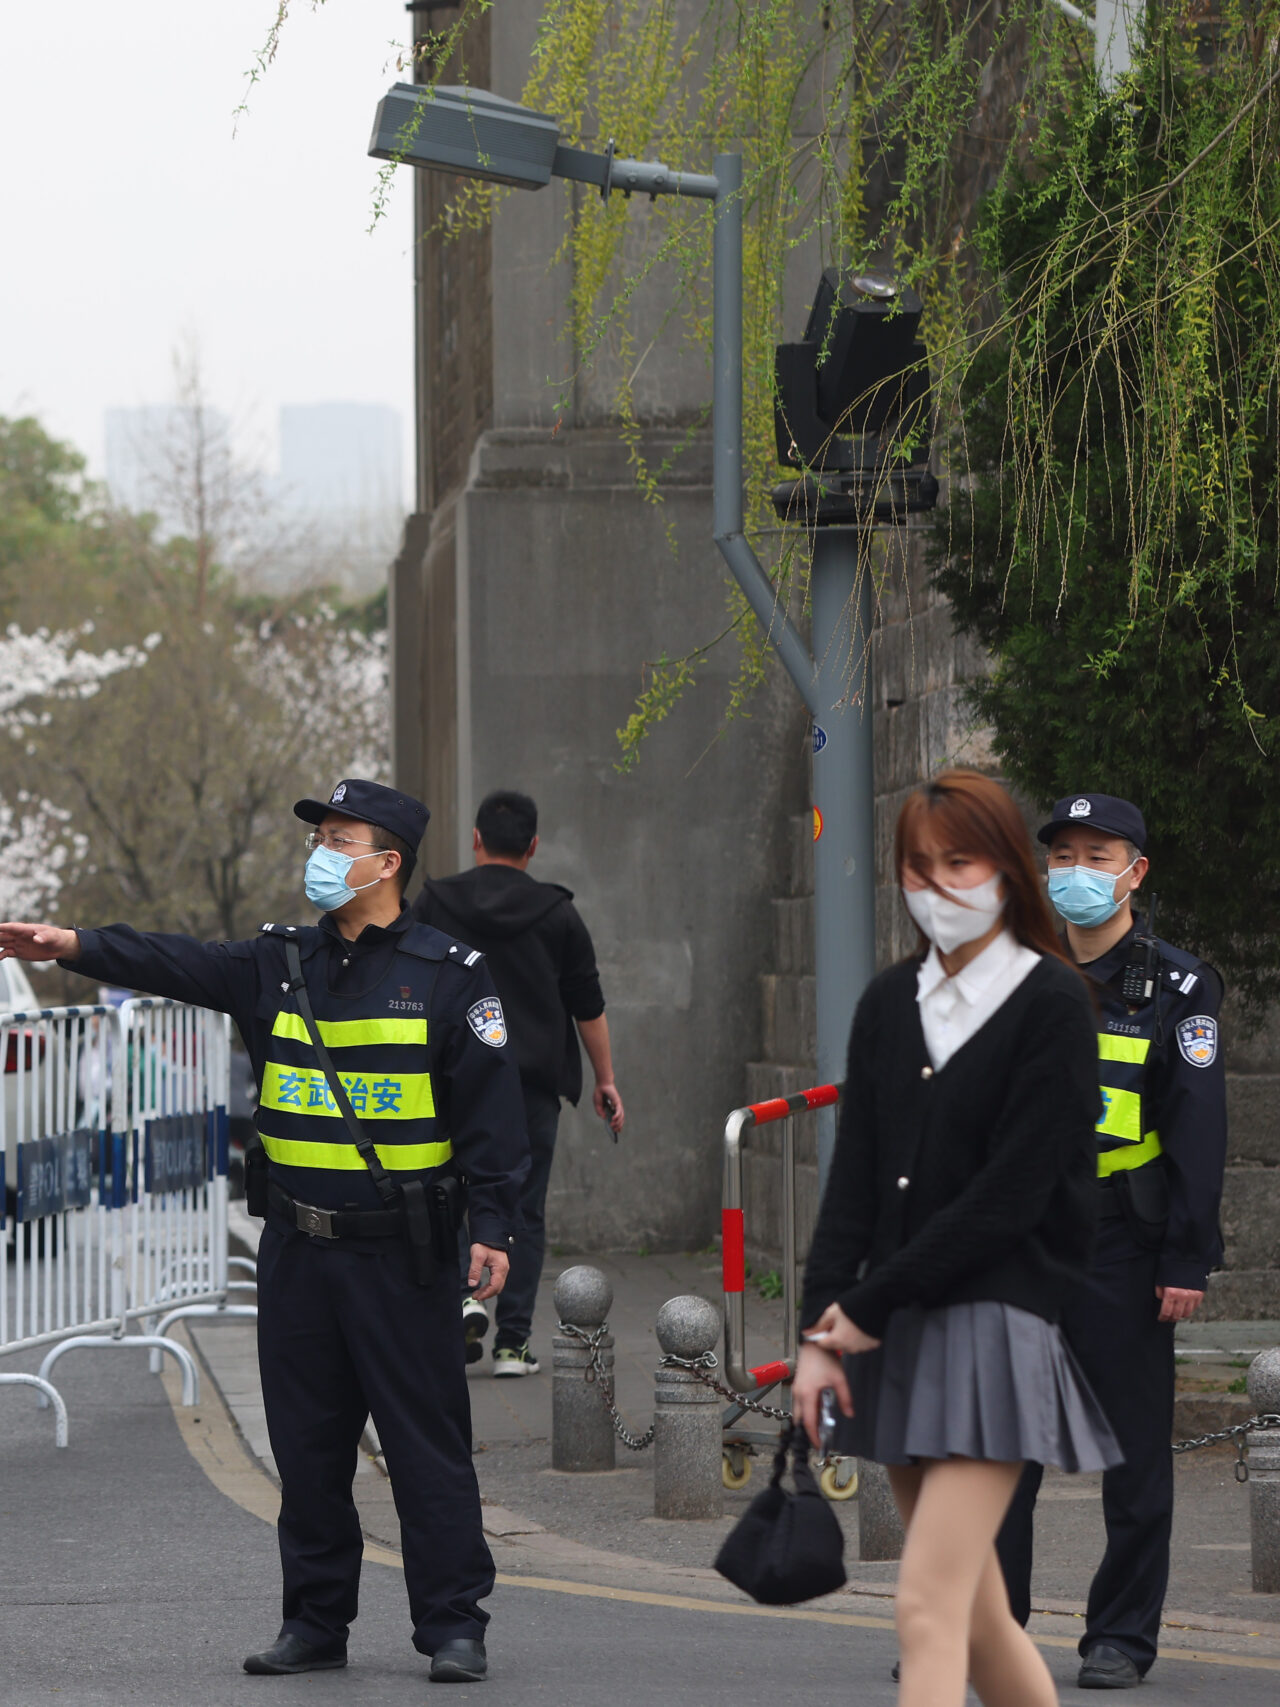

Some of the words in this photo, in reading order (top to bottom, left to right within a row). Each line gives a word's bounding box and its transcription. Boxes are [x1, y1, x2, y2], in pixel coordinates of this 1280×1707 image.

[388, 999, 424, 1012] 213763
[277, 1071, 403, 1114] 玄武治安
